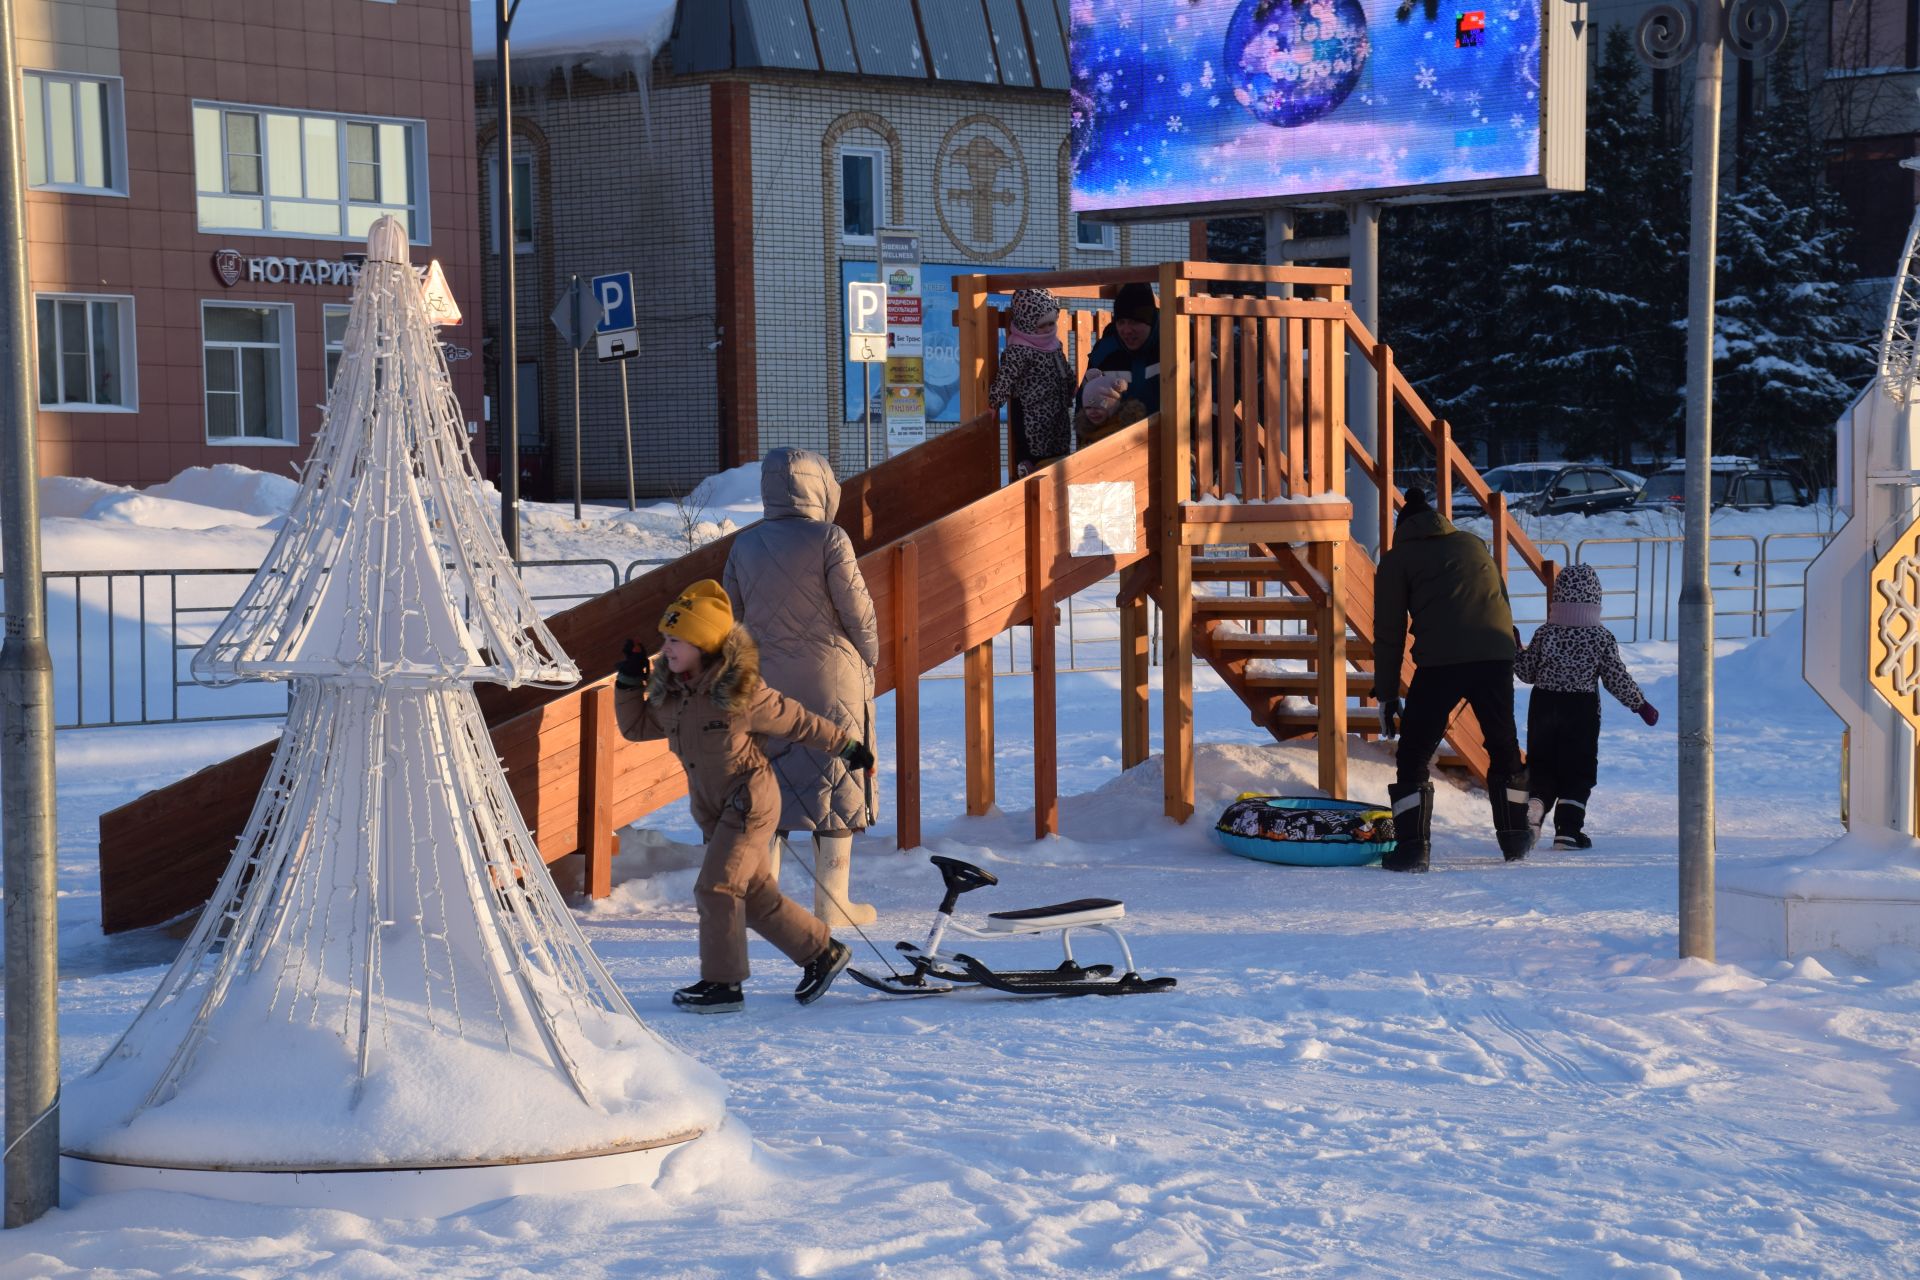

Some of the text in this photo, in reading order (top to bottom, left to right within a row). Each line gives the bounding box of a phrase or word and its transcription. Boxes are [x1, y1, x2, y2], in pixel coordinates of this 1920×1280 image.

[881, 243, 909, 251] SIBERIAN
[601, 281, 624, 326] P
[857, 289, 878, 330] P
